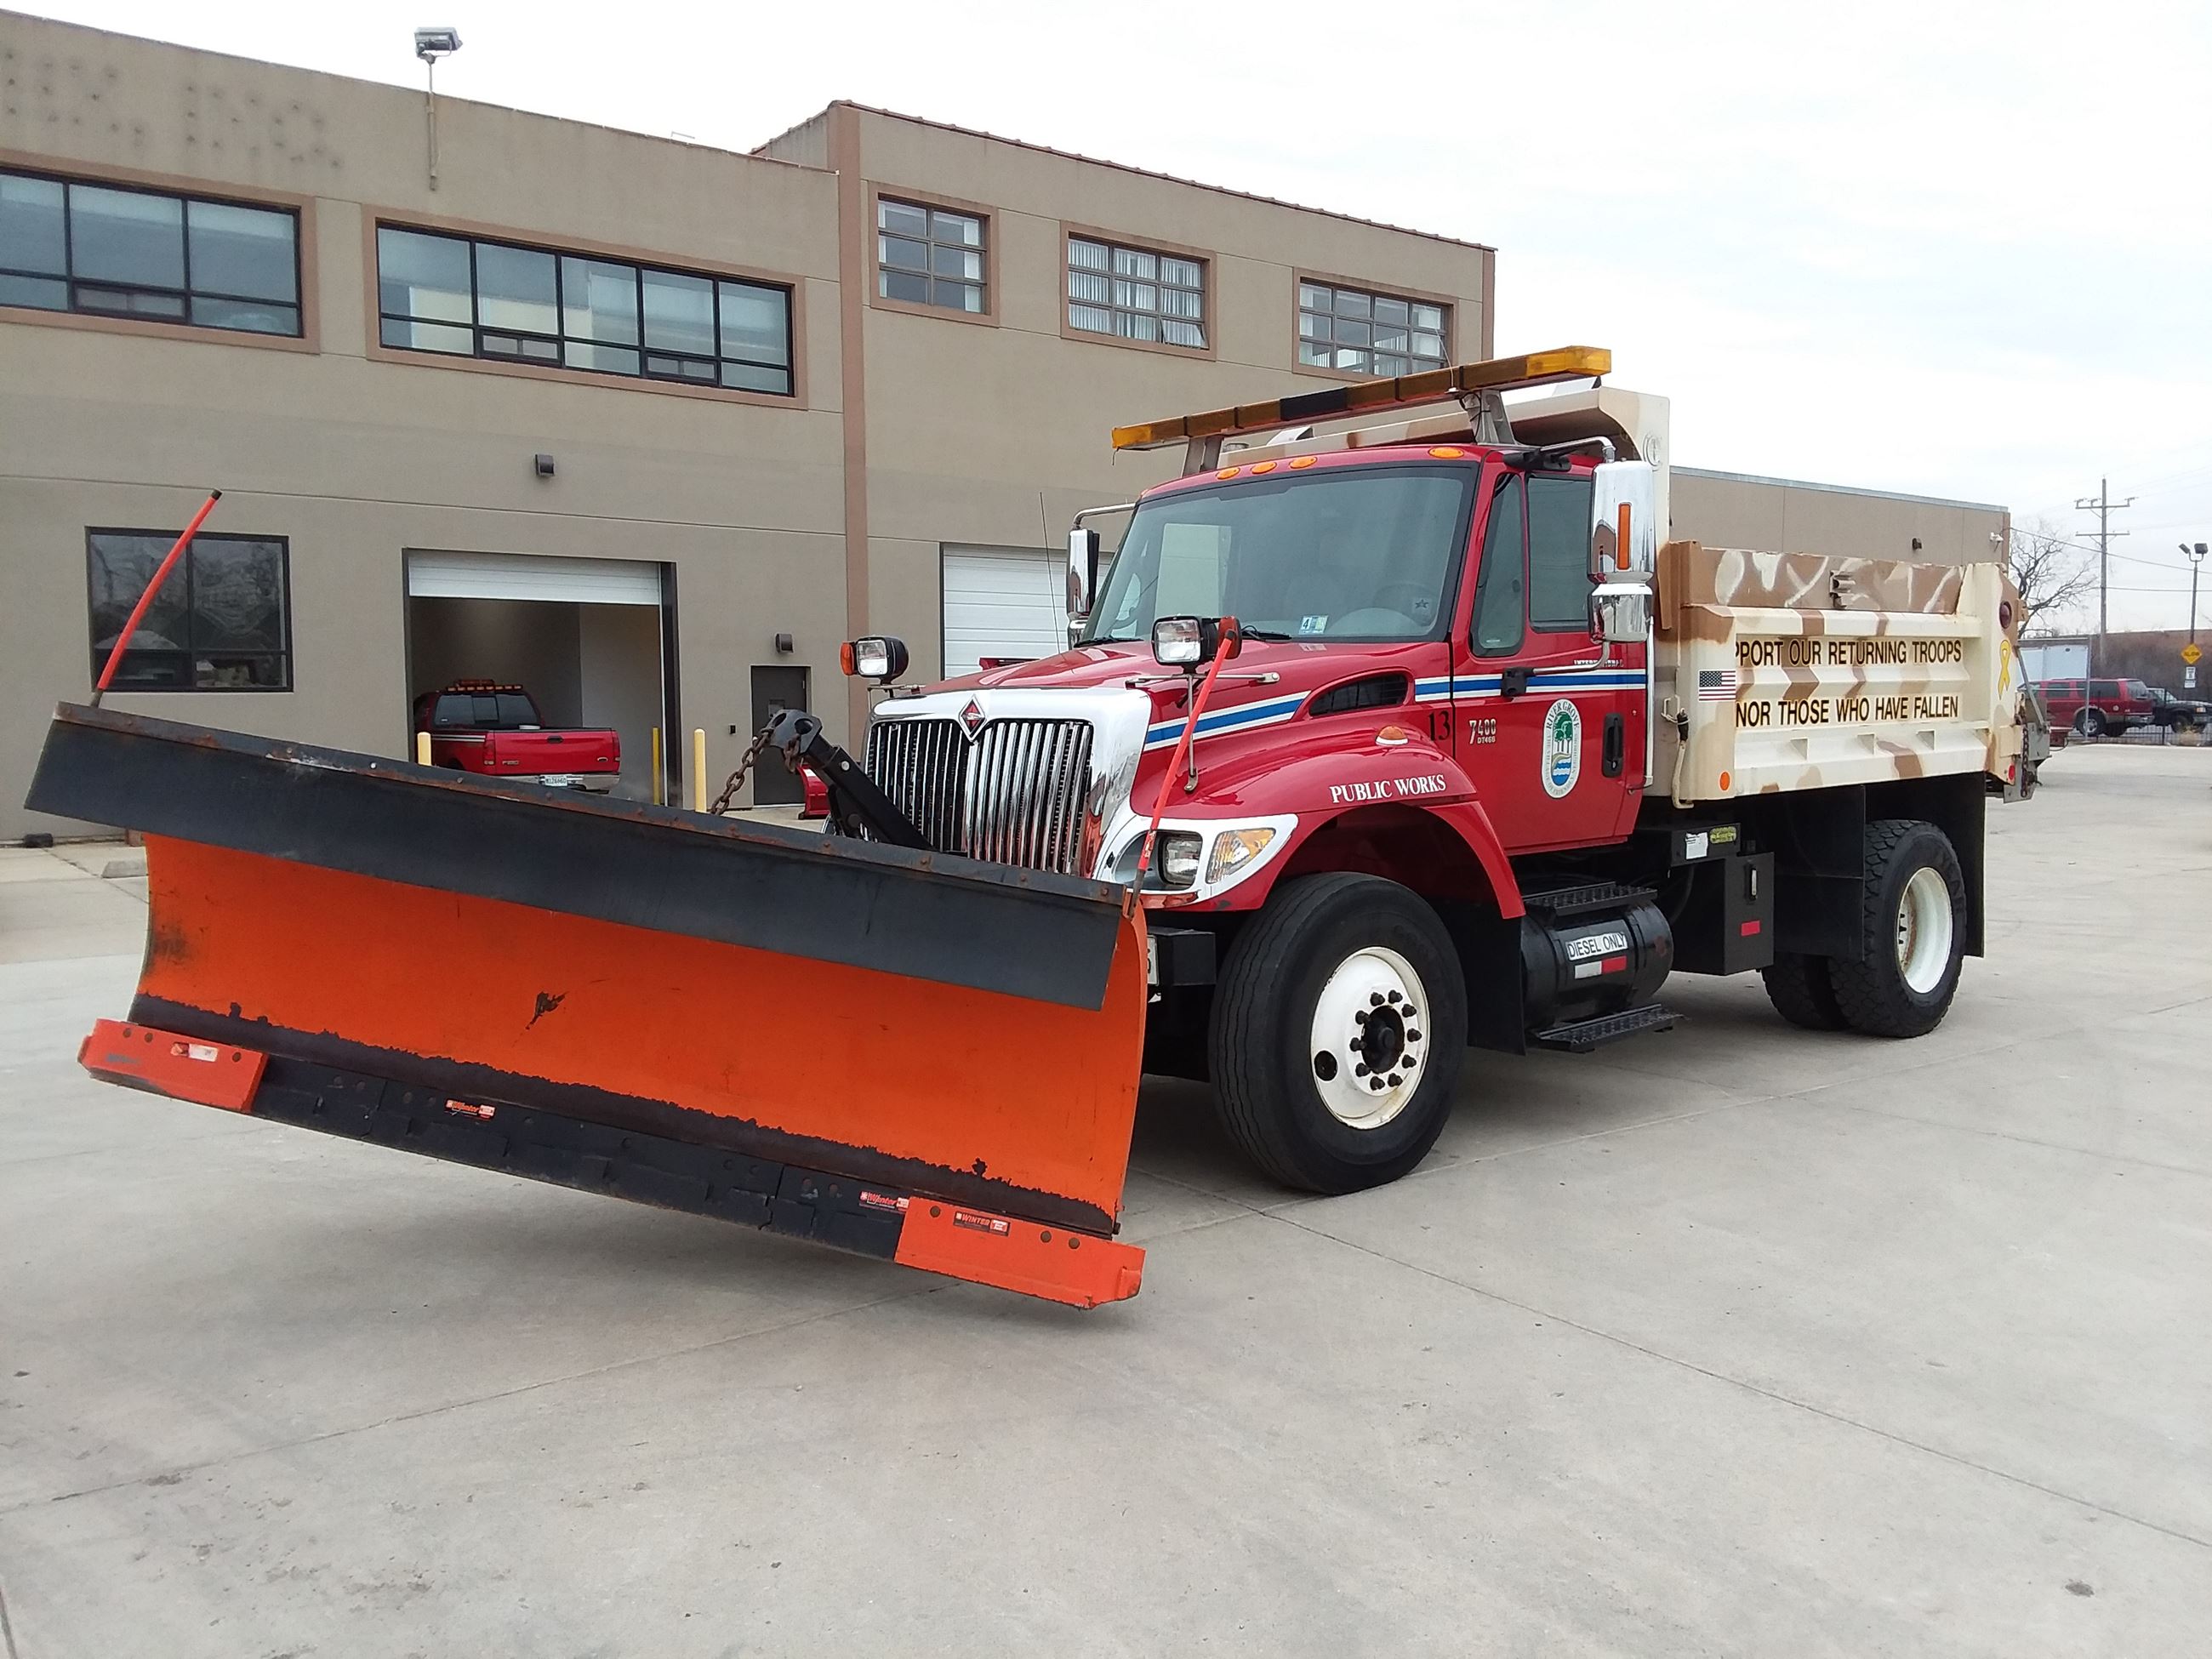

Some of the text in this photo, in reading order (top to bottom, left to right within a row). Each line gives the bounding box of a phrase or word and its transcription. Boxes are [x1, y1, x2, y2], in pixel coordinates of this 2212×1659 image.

[1303, 619, 1310, 629] 4
[1789, 640, 1821, 665] OUR
[1828, 641, 1907, 665] RETURNING
[1912, 640, 1962, 664] TROOPS
[1546, 700, 1580, 730] RIVER GROVE
[1736, 696, 1958, 727] NOR THOSE WHO HAVE FALLEN
[1428, 710, 1451, 741] 13
[1468, 718, 1497, 744] 7400
[1329, 774, 1446, 803] PUBLIC WORKS
[1567, 932, 1625, 958] DIESEL ONLY
[961, 1213, 990, 1226] WINTER
